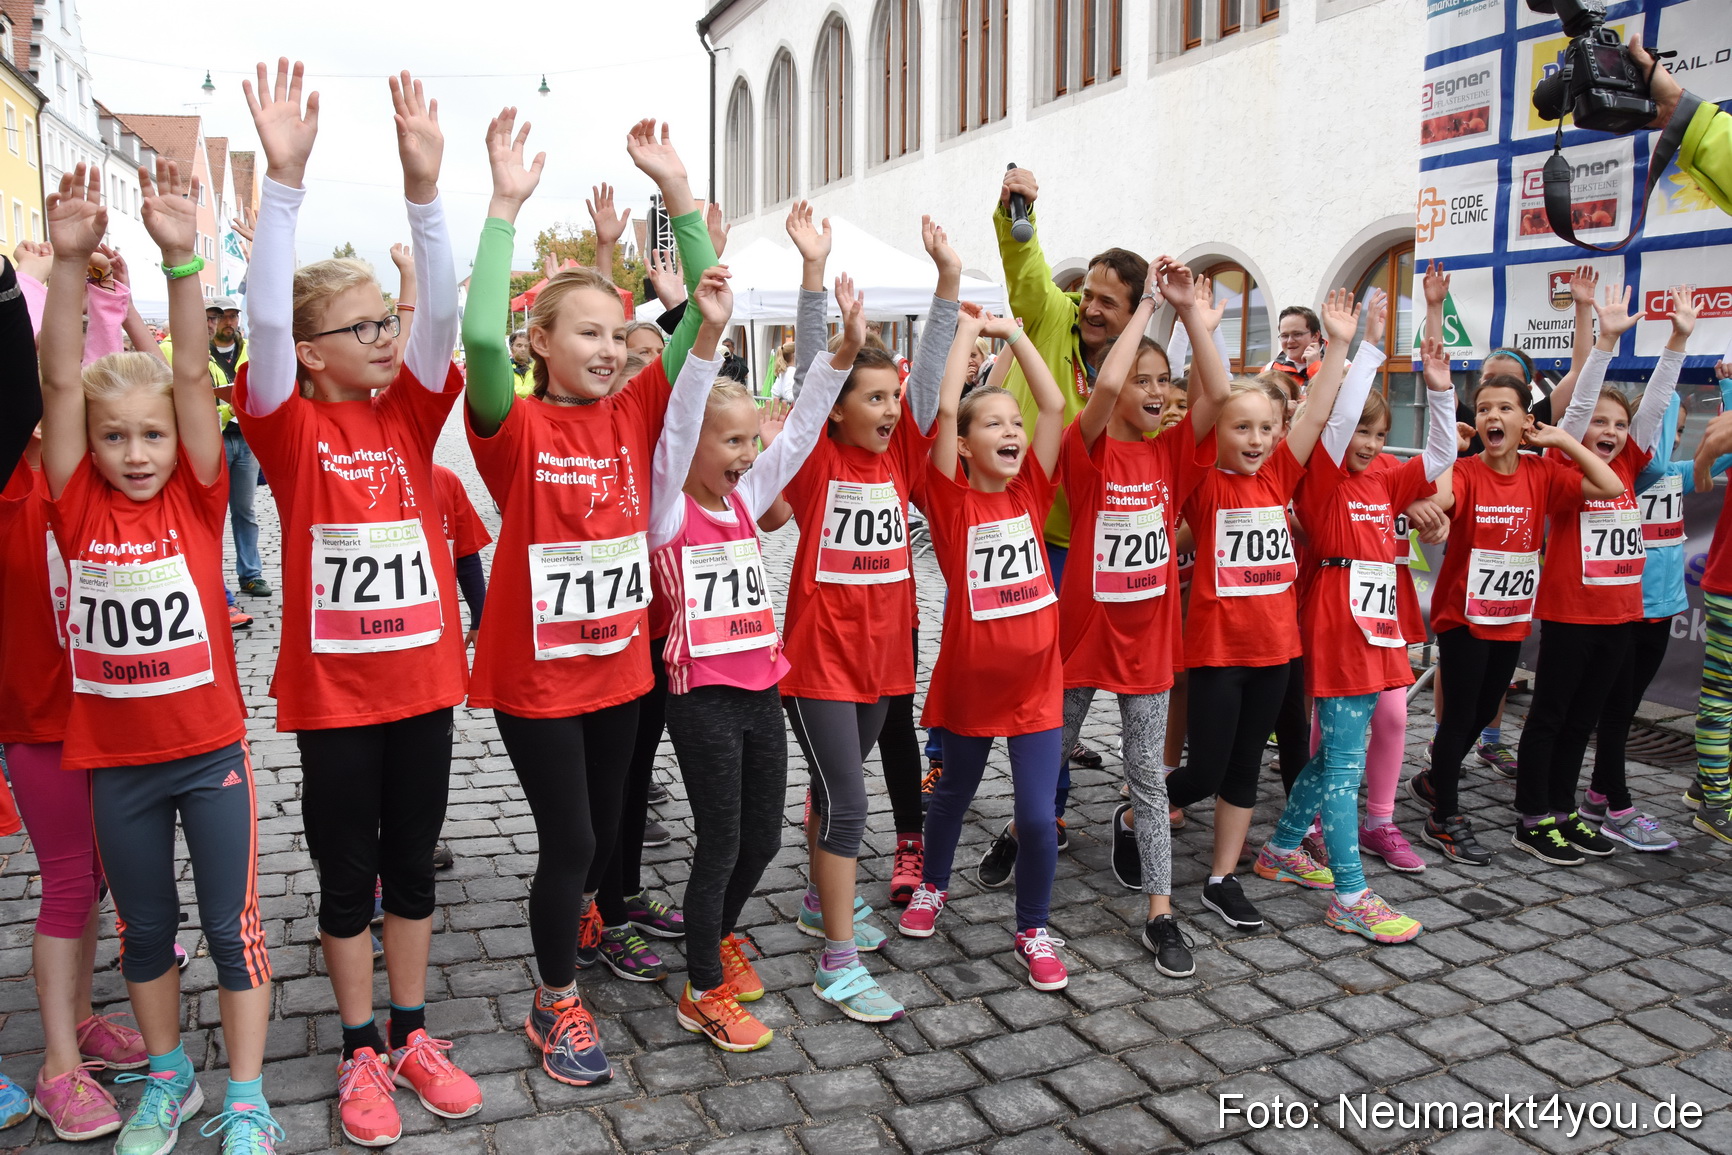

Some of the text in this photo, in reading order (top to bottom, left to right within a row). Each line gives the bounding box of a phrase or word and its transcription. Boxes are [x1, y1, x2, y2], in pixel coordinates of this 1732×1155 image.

[1458, 8, 1472, 18] Hier
[1472, 4, 1486, 14] lebe
[1434, 70, 1490, 96] egner
[1434, 88, 1490, 108] PFLASTERSTEINE
[1452, 194, 1484, 210] CODE
[1450, 208, 1488, 225] CLINIC
[1106, 495, 1148, 506] Stadtlau
[1642, 492, 1682, 520] 717
[833, 506, 903, 546] 7038
[1476, 515, 1514, 525] tadtlauf
[369, 524, 419, 543] BOCK
[1591, 528, 1643, 556] 7093
[592, 536, 640, 559] BOCK
[1105, 527, 1167, 567] 7202
[1226, 528, 1291, 562] 7032
[541, 555, 583, 563] NeuerMarkt
[690, 556, 728, 565] NeuerMarkt
[852, 556, 890, 570] Alicia
[975, 537, 1038, 582] 7217
[114, 562, 182, 586] BOCK
[324, 550, 428, 603] 7211
[1127, 574, 1157, 589] Lucia
[1244, 569, 1281, 584] Sophie
[1479, 569, 1535, 596] 7426
[547, 562, 644, 616] 7174
[695, 565, 766, 612] 7194
[1000, 586, 1039, 604] Melina
[59, 601, 65, 609] 5
[1479, 600, 1518, 616] Sarah
[80, 591, 194, 648] 7092
[360, 617, 404, 634] Lena
[729, 618, 762, 636] Alina
[198, 631, 204, 640] K
[580, 623, 618, 640] Lena
[75, 639, 80, 648] 5
[102, 660, 170, 683] Sophia
[222, 778, 242, 787] adidas
